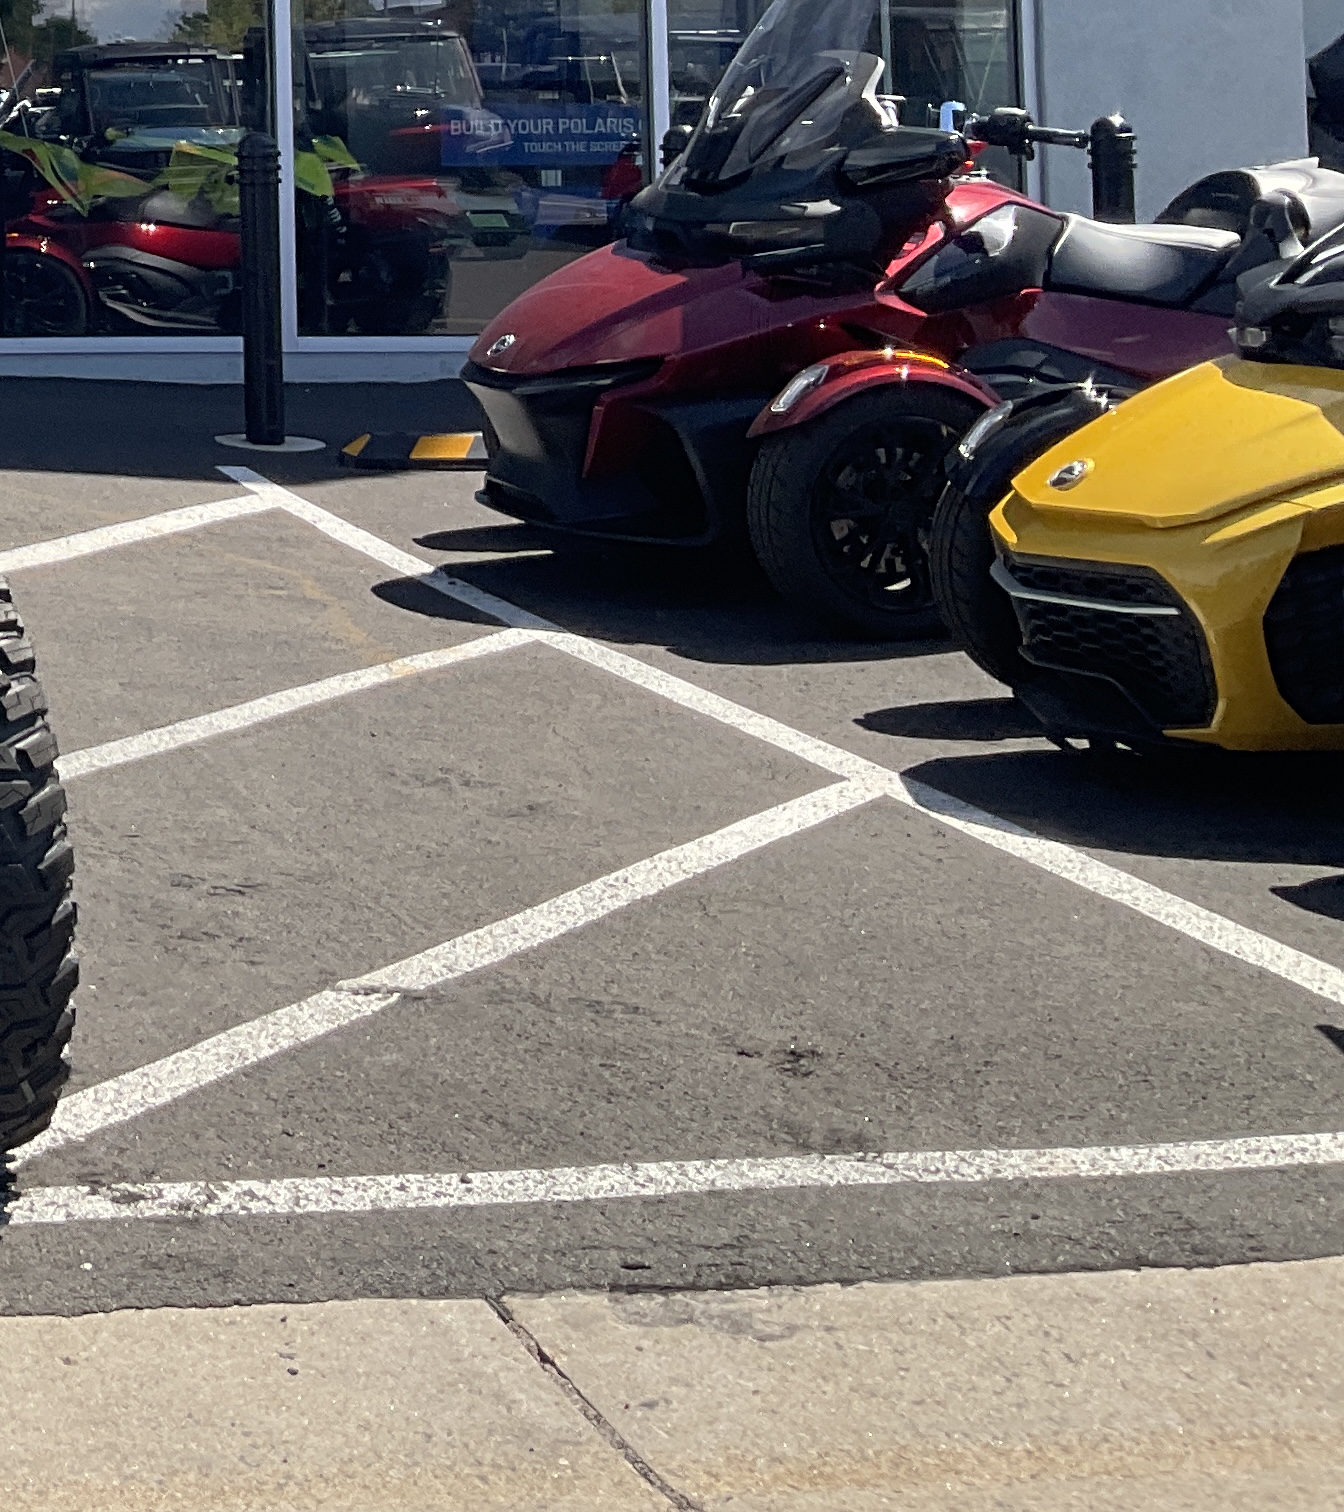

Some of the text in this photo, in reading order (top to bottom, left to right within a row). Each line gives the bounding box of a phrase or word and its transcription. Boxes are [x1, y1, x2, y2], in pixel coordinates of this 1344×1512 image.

[450, 118, 503, 136] BUILD
[510, 119, 554, 135] YOUR
[558, 118, 635, 135] POLARIS
[524, 141, 562, 154] TOUCH
[565, 141, 586, 153] THE
